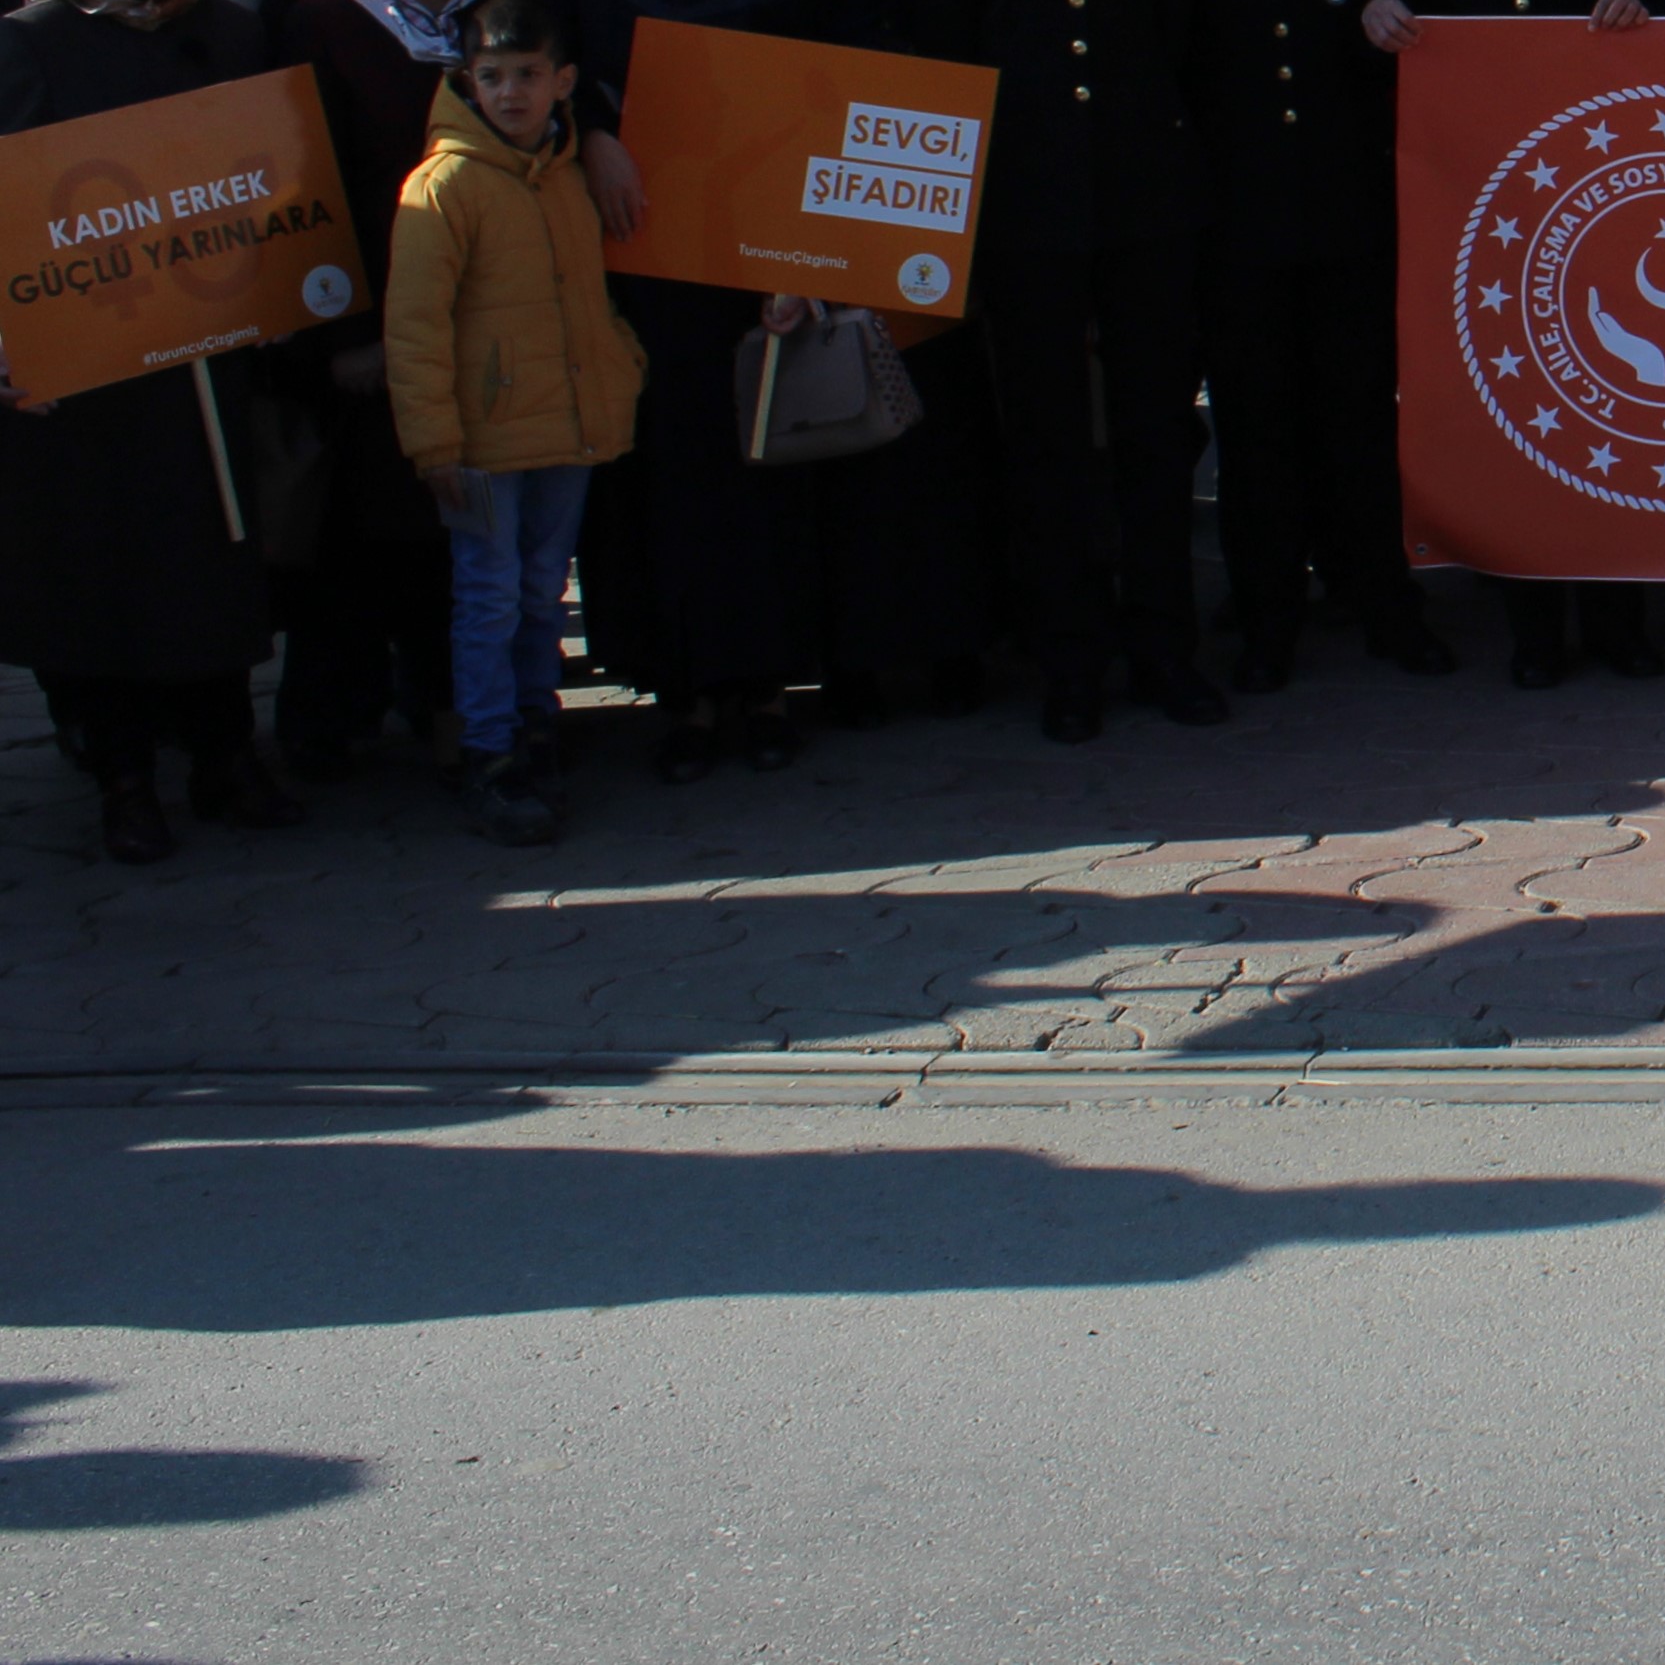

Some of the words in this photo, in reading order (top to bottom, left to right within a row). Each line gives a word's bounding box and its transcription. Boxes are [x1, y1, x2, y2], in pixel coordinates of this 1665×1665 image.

[851, 114, 968, 162] SEVGİ,
[48, 196, 161, 249] KADIN
[170, 170, 271, 219] ERKEK
[811, 165, 961, 217] ŞİFADIR!
[1573, 182, 1610, 213] VE
[8, 243, 133, 305] GÜÇLÜ
[142, 199, 333, 271] YARINLARA
[1533, 212, 1581, 318] ÇALIŞMA
[1539, 323, 1581, 382] AİLE,
